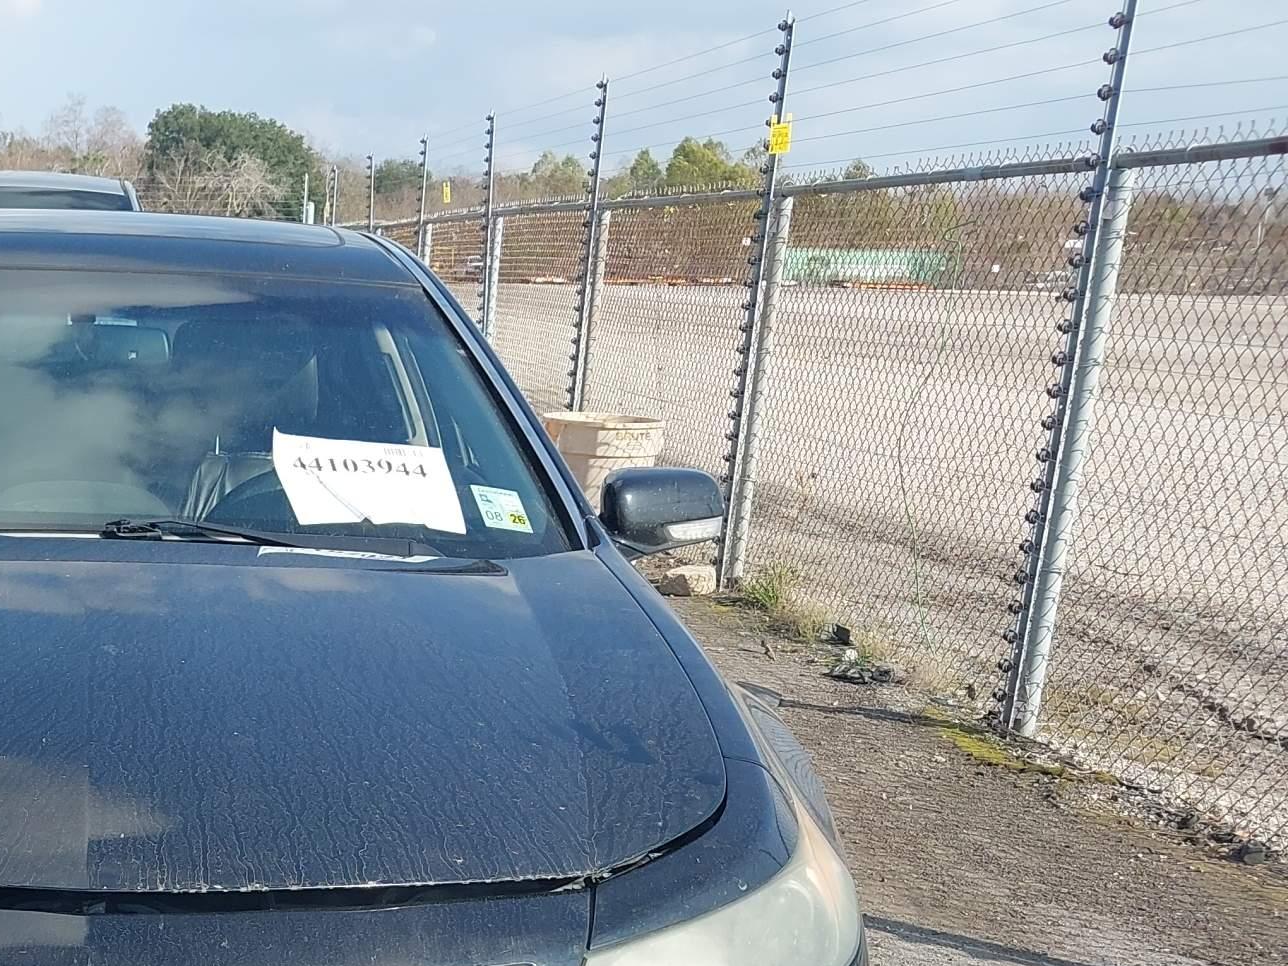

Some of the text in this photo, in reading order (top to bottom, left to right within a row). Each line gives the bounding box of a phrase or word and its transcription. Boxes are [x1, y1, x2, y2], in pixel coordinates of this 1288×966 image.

[292, 456, 428, 478] 44103944
[485, 510, 504, 522] 08
[509, 513, 526, 525] 26
